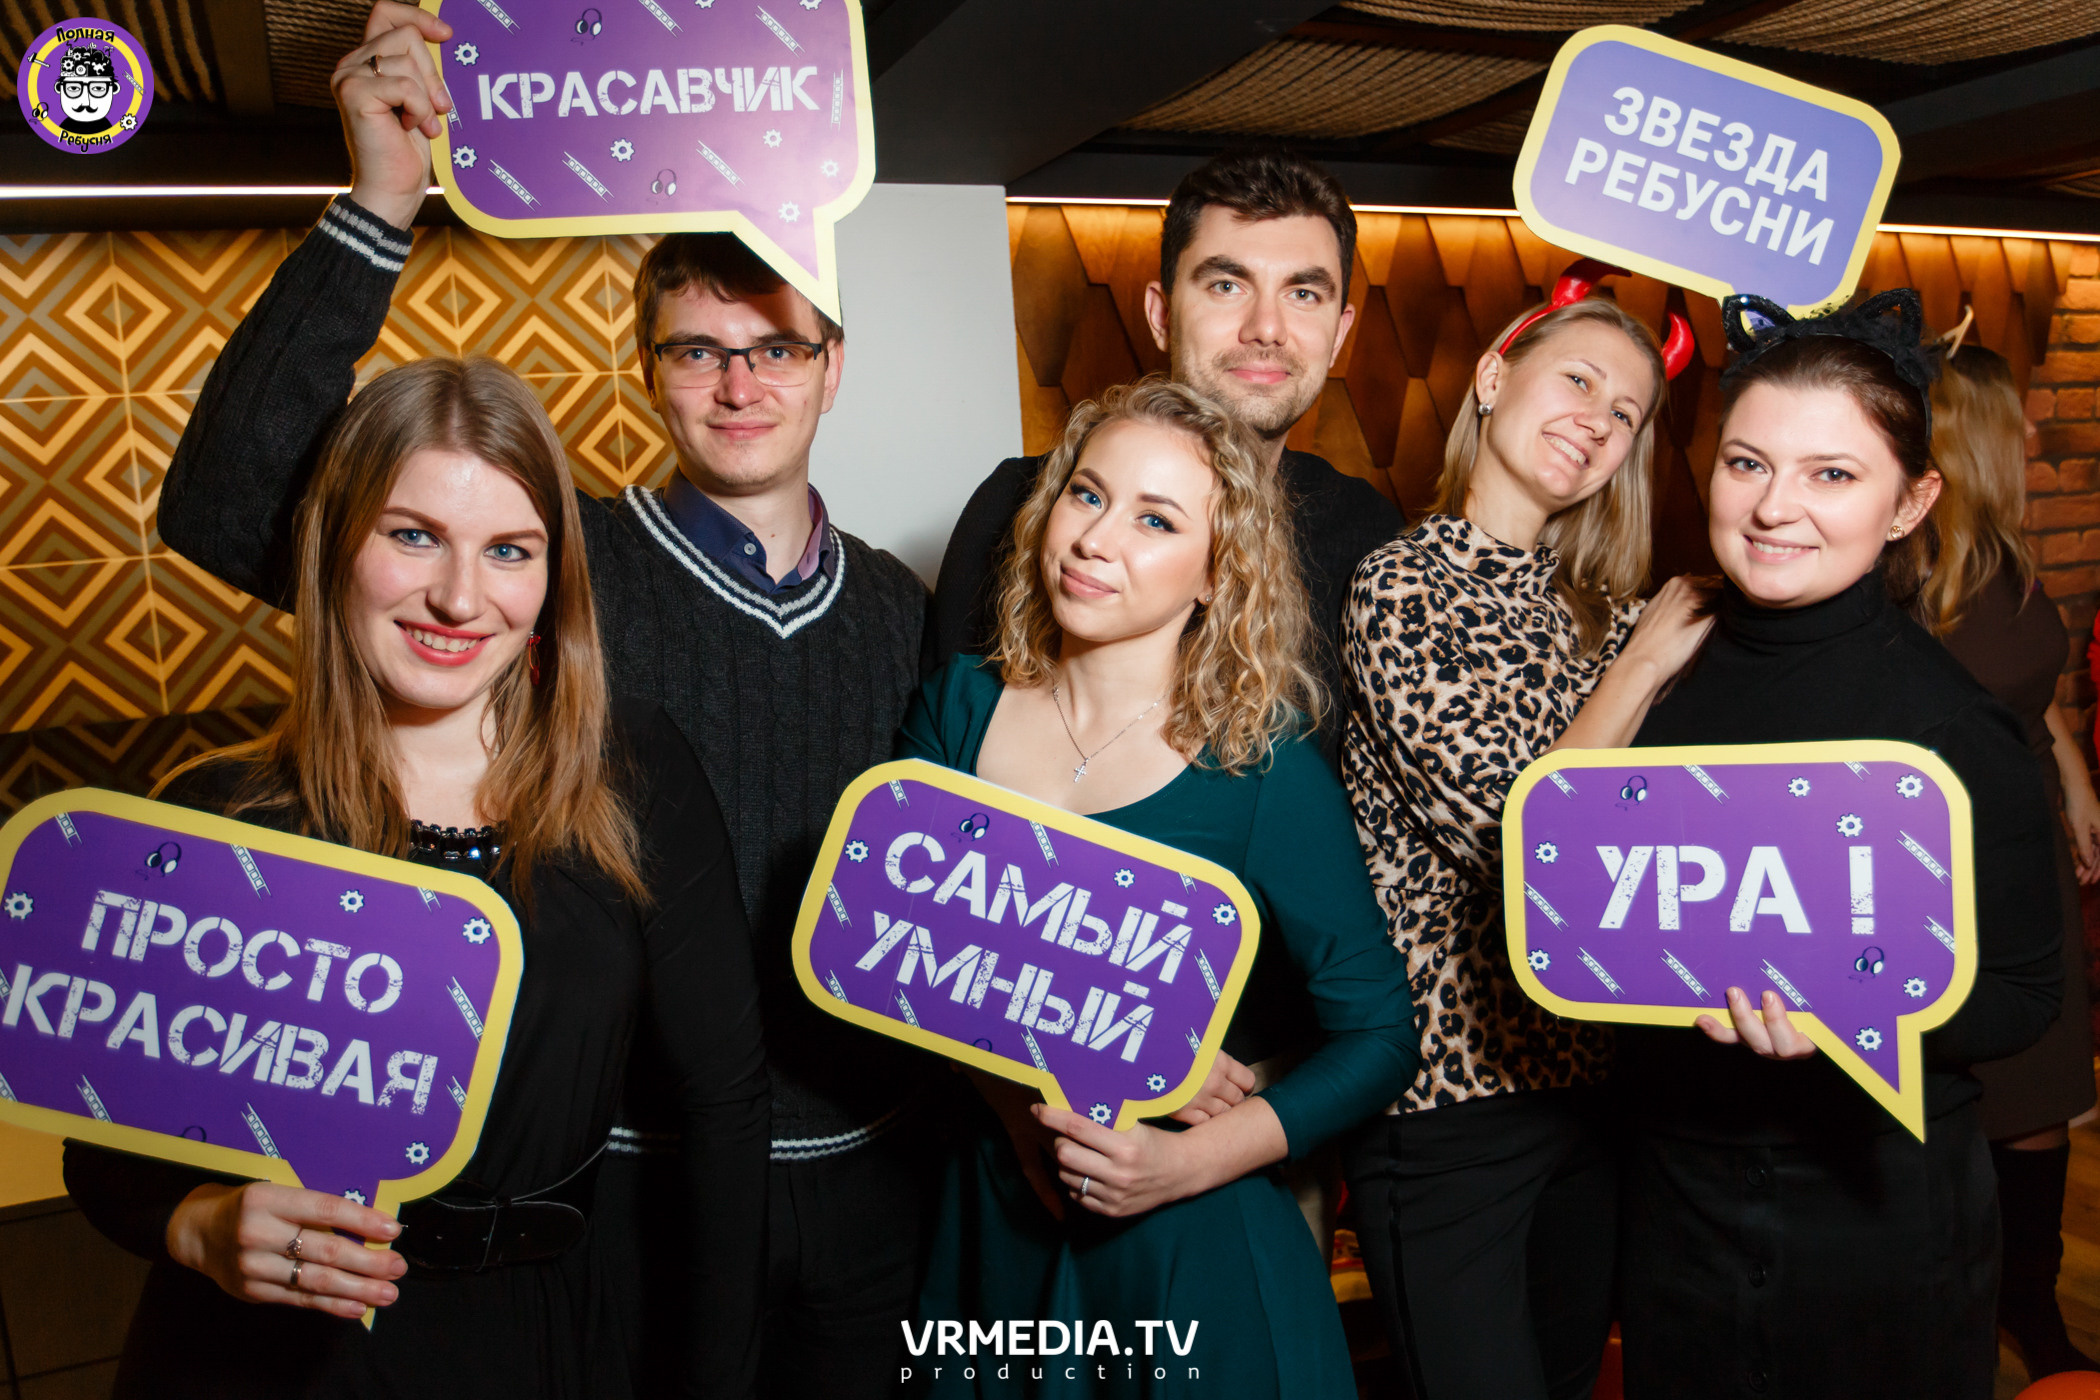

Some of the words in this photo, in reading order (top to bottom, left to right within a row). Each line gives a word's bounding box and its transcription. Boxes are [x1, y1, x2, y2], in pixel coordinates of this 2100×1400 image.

[478, 66, 820, 120] КРАСАВЧИК
[1604, 86, 1828, 202] ЗВЕЗДА
[1565, 137, 1834, 266] РЕБУСНИ
[81, 890, 403, 1013] ПРОСТО
[885, 831, 1193, 985] САМЫЙ
[1596, 845, 1812, 933] УРА
[2, 964, 438, 1115] КРАСИВАЯ
[854, 910, 1154, 1063] УМНЫЙ
